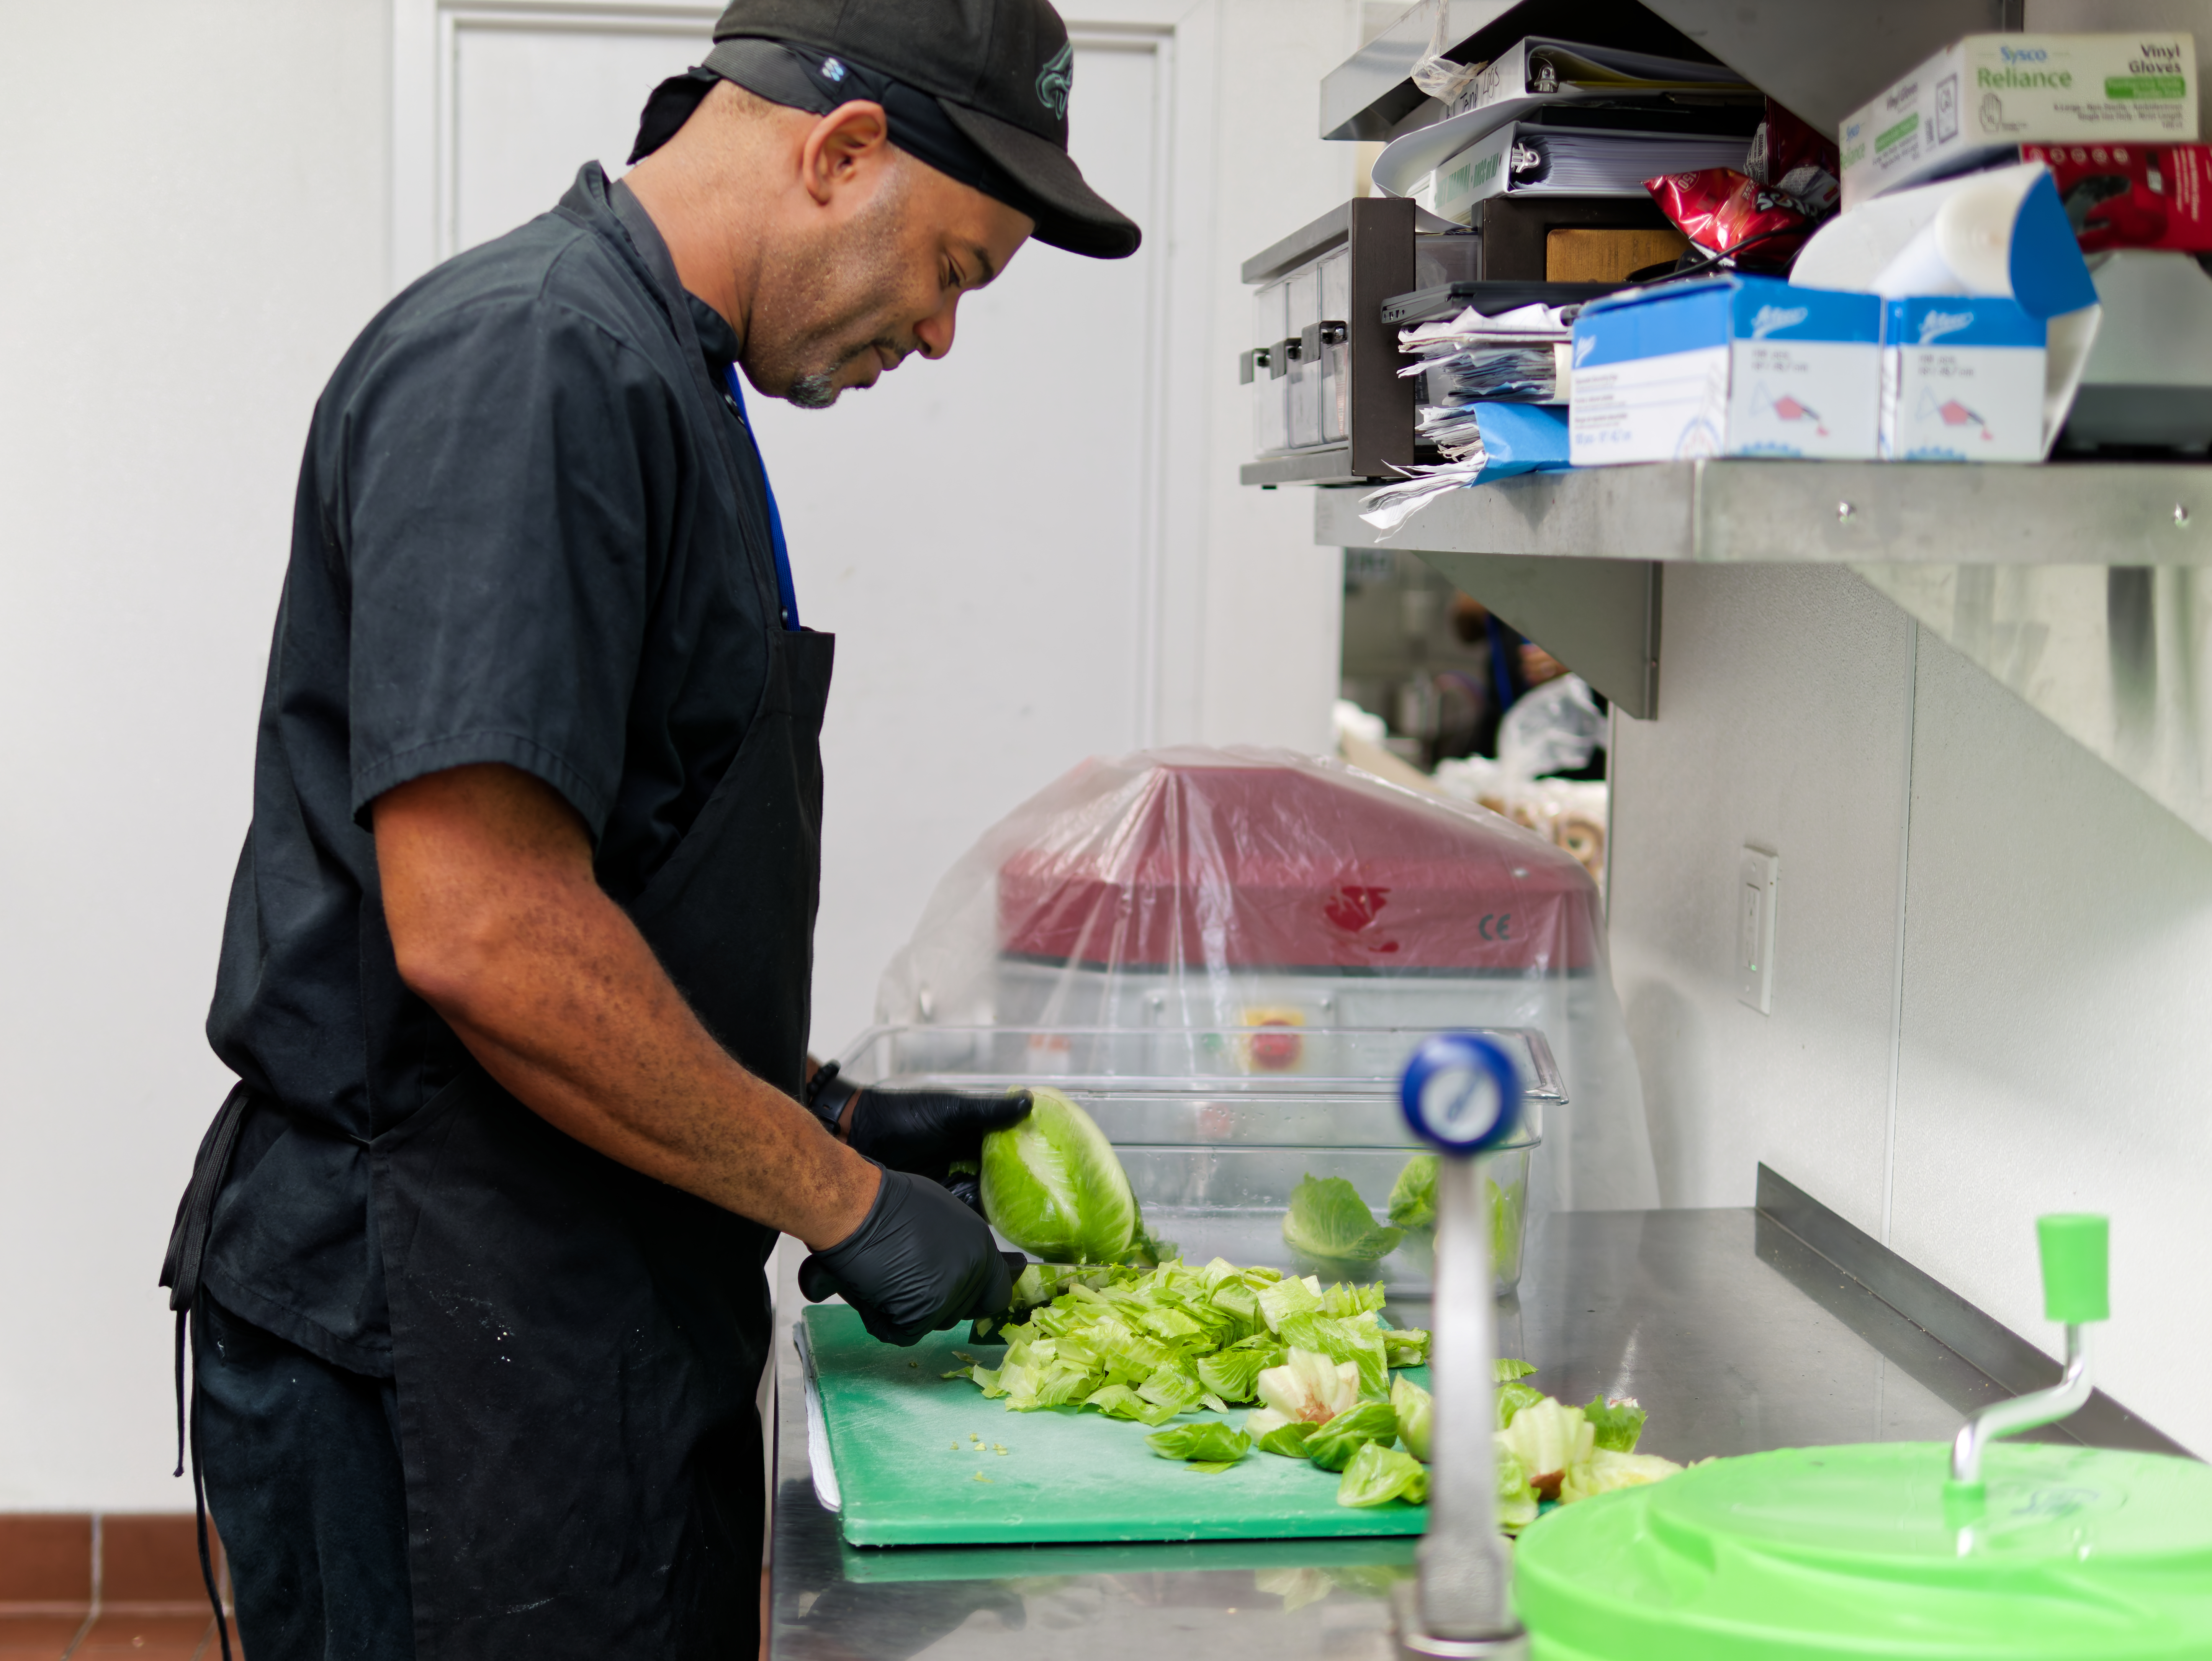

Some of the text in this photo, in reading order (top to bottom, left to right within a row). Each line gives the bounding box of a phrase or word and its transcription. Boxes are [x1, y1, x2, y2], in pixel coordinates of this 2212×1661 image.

[2000, 46, 2047, 65] Sysco
[2141, 43, 2181, 60] Vinyl
[2129, 59, 2181, 73] Gloves
[1977, 66, 2072, 88] Reliance
[1678, 174, 1696, 189] 150
